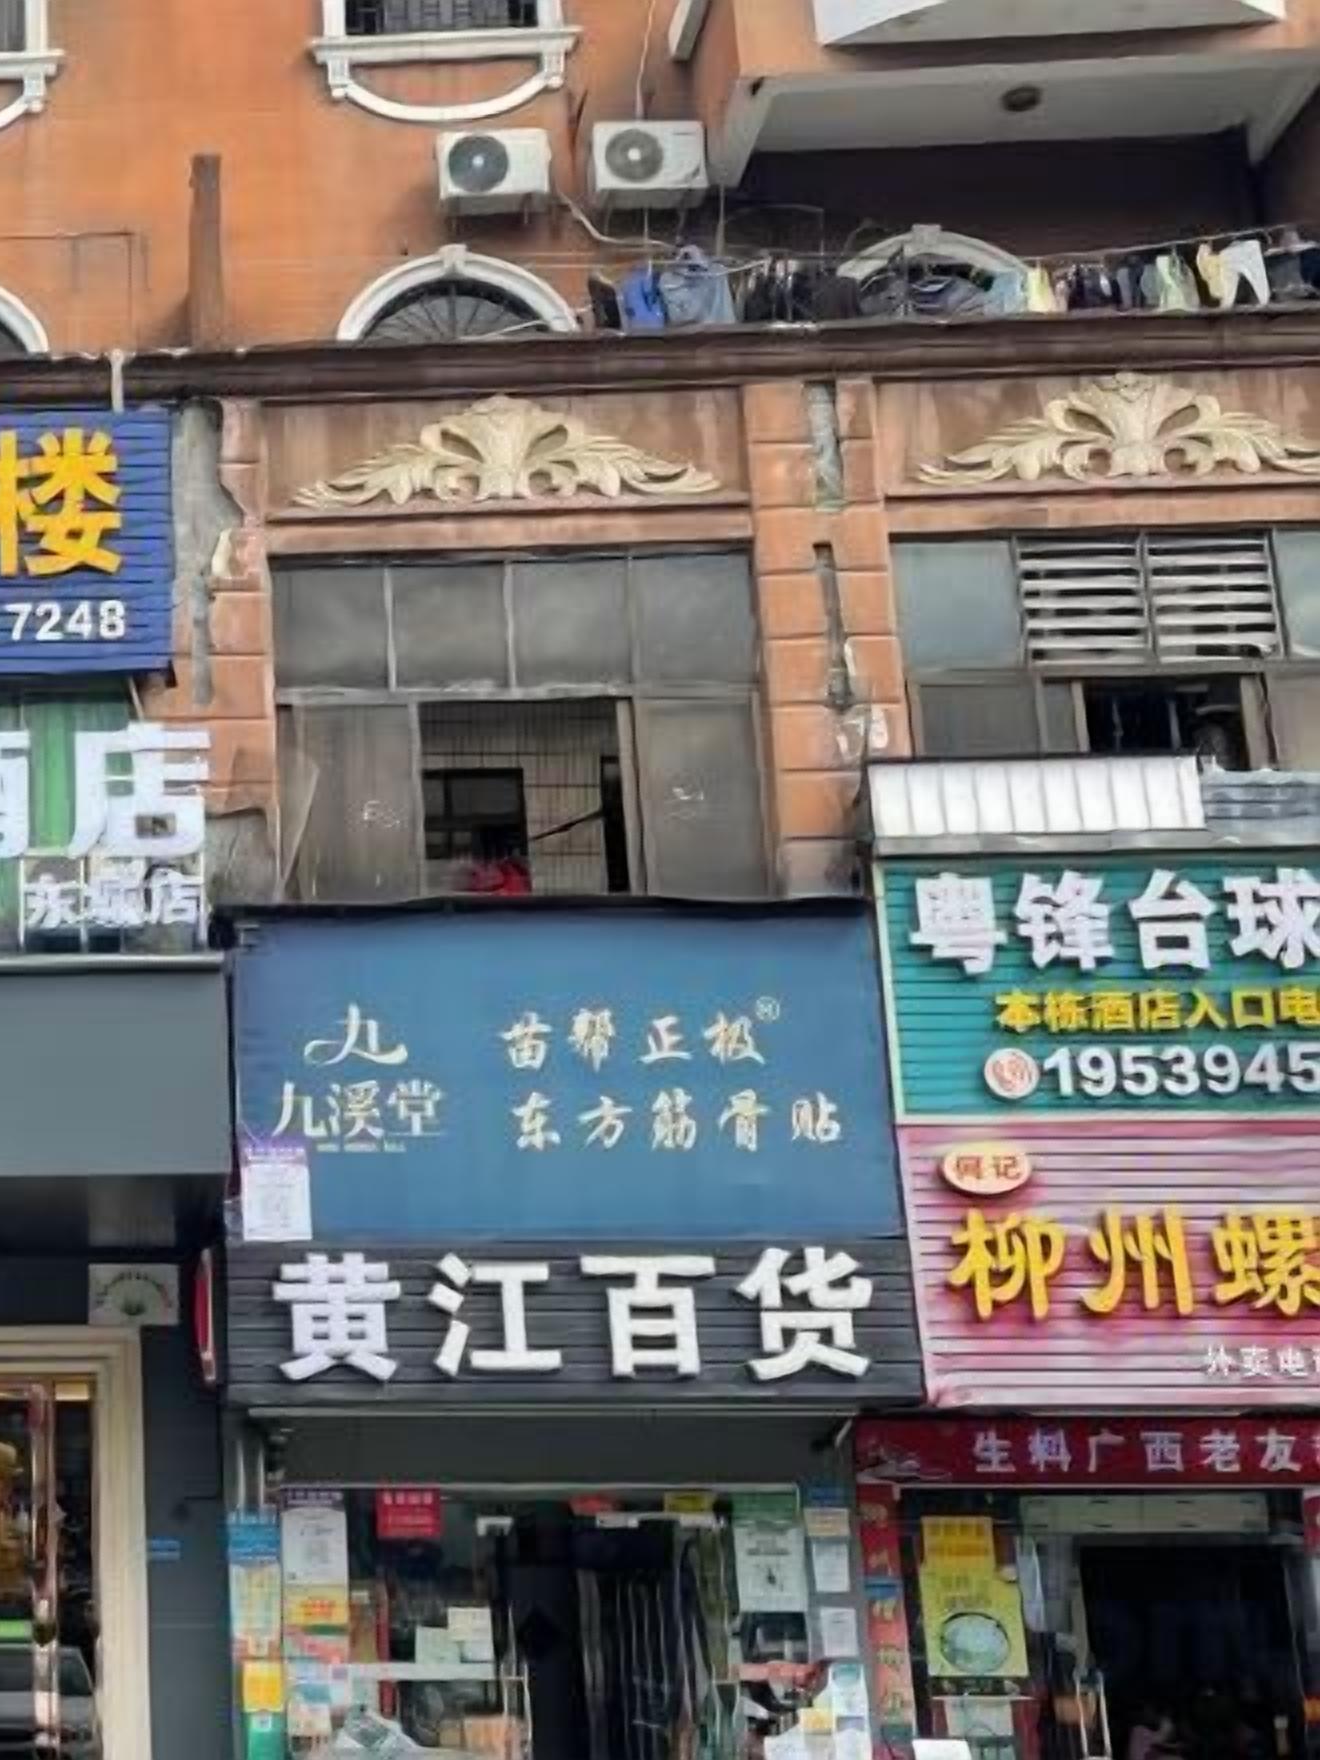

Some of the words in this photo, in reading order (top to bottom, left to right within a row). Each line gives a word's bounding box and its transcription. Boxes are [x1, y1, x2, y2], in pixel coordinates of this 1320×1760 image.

[910, 866, 1320, 976] 粤锋台球
[512, 1087, 842, 1152] 东方筋骨贴
[947, 1205, 1320, 1322] 柳州螺
[272, 1245, 875, 1382] 黄江百货
[1204, 1345, 1320, 1378] 外卖电
[973, 1427, 1320, 1475] 生料广西老友
